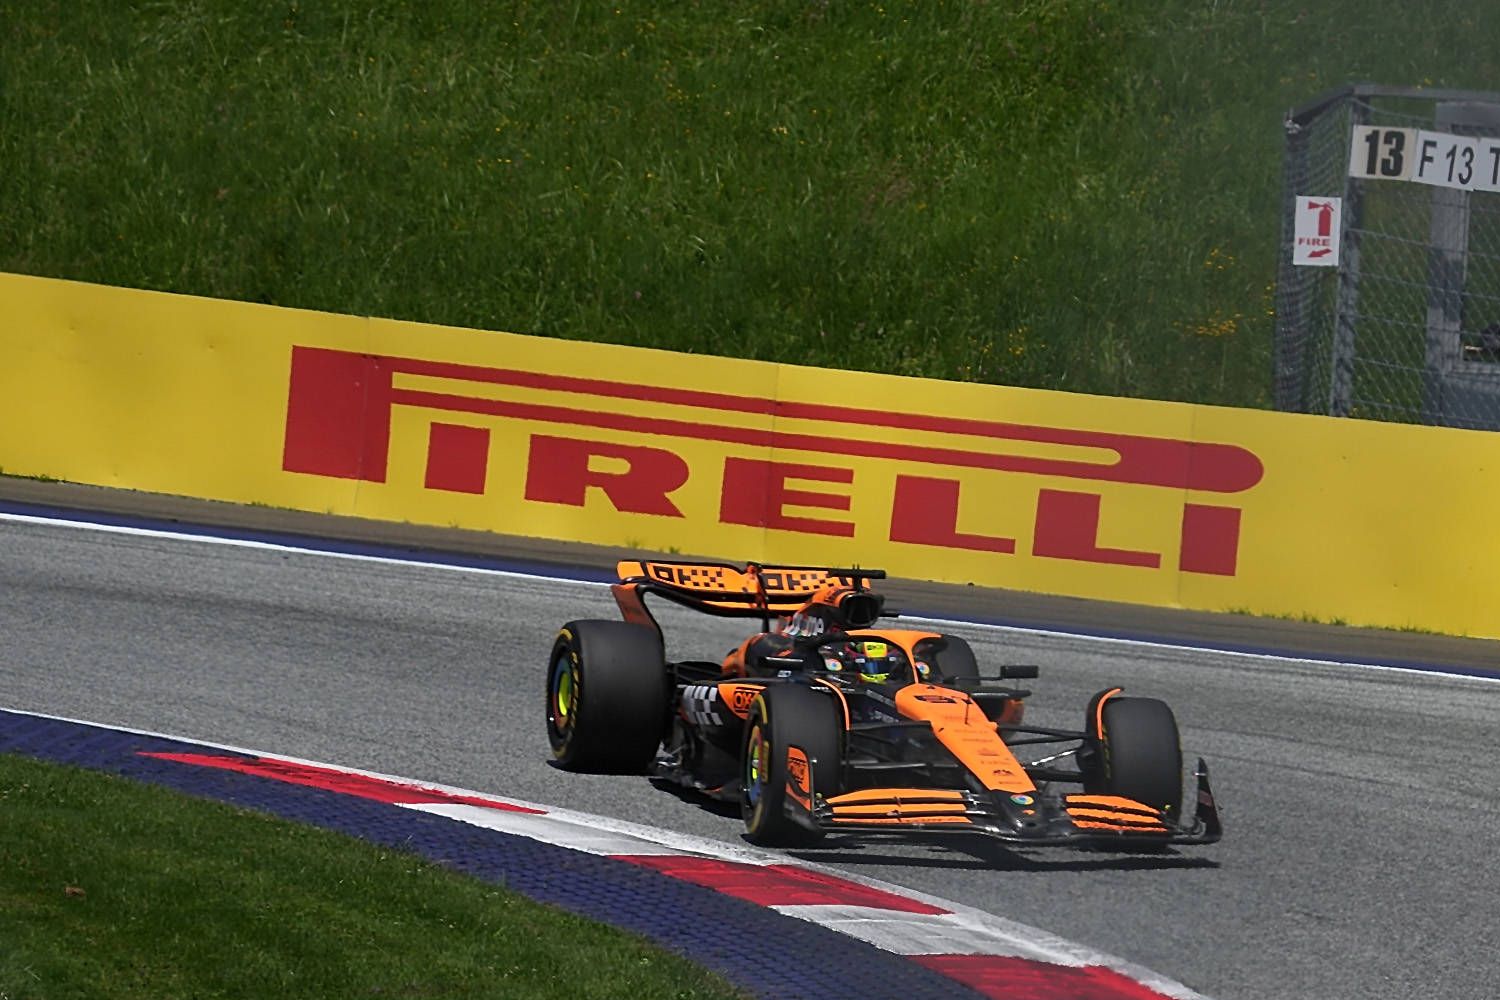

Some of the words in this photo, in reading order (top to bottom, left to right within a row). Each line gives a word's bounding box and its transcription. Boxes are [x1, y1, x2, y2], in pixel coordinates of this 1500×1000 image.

[1365, 130, 1405, 176] 13
[1419, 140, 1437, 177] F
[1445, 144, 1474, 185] 13
[1298, 237, 1331, 247] FIRE
[282, 345, 1264, 577] PIRELLI
